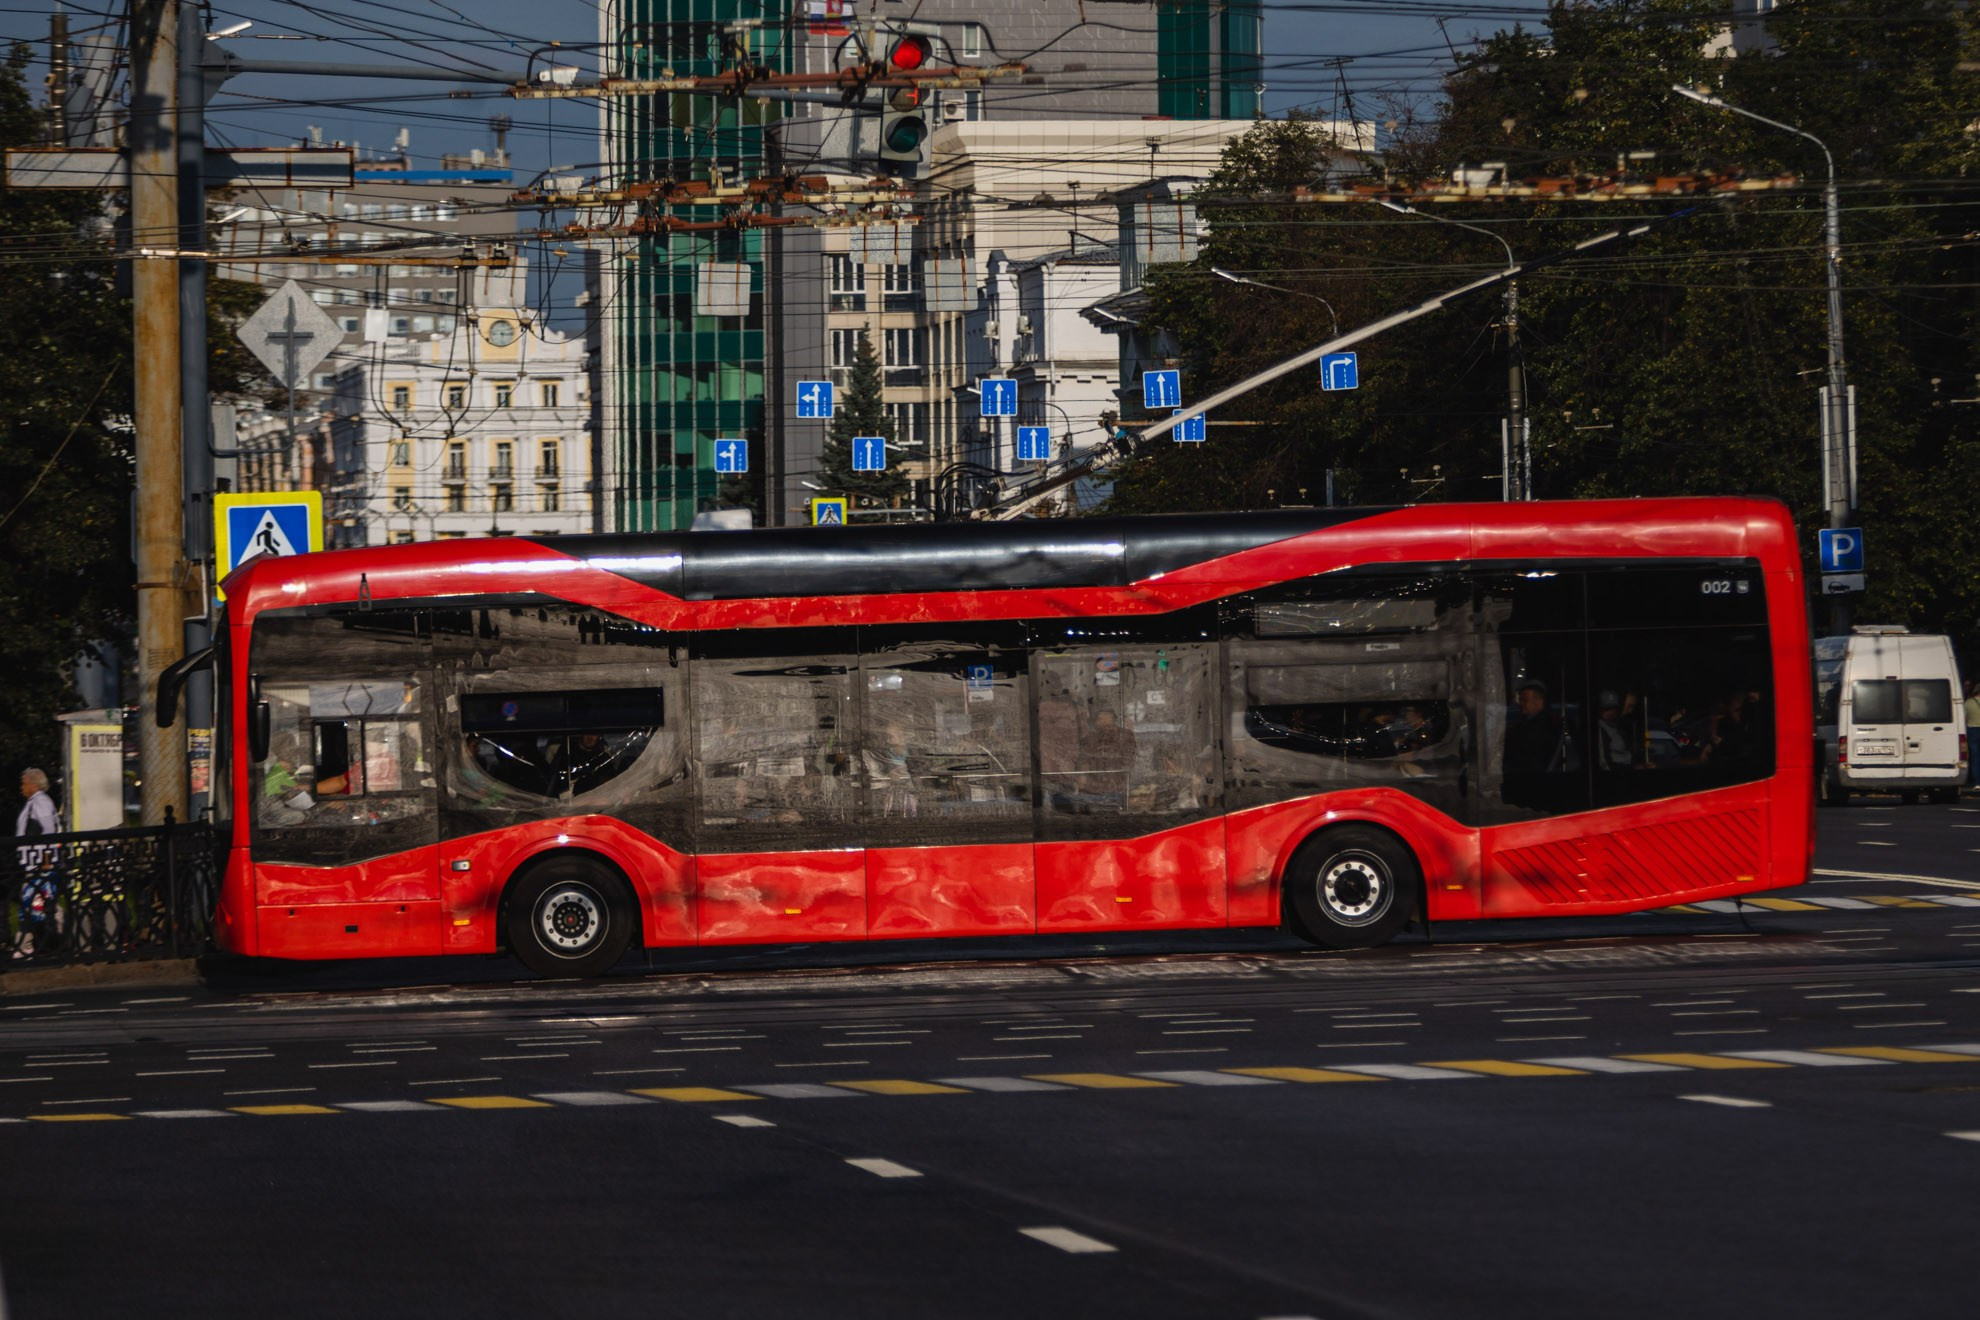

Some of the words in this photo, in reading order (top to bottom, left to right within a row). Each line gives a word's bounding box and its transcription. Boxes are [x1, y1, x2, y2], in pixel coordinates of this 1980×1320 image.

[1832, 534, 1854, 566] P
[1702, 581, 1730, 593] 002
[974, 667, 988, 687] P
